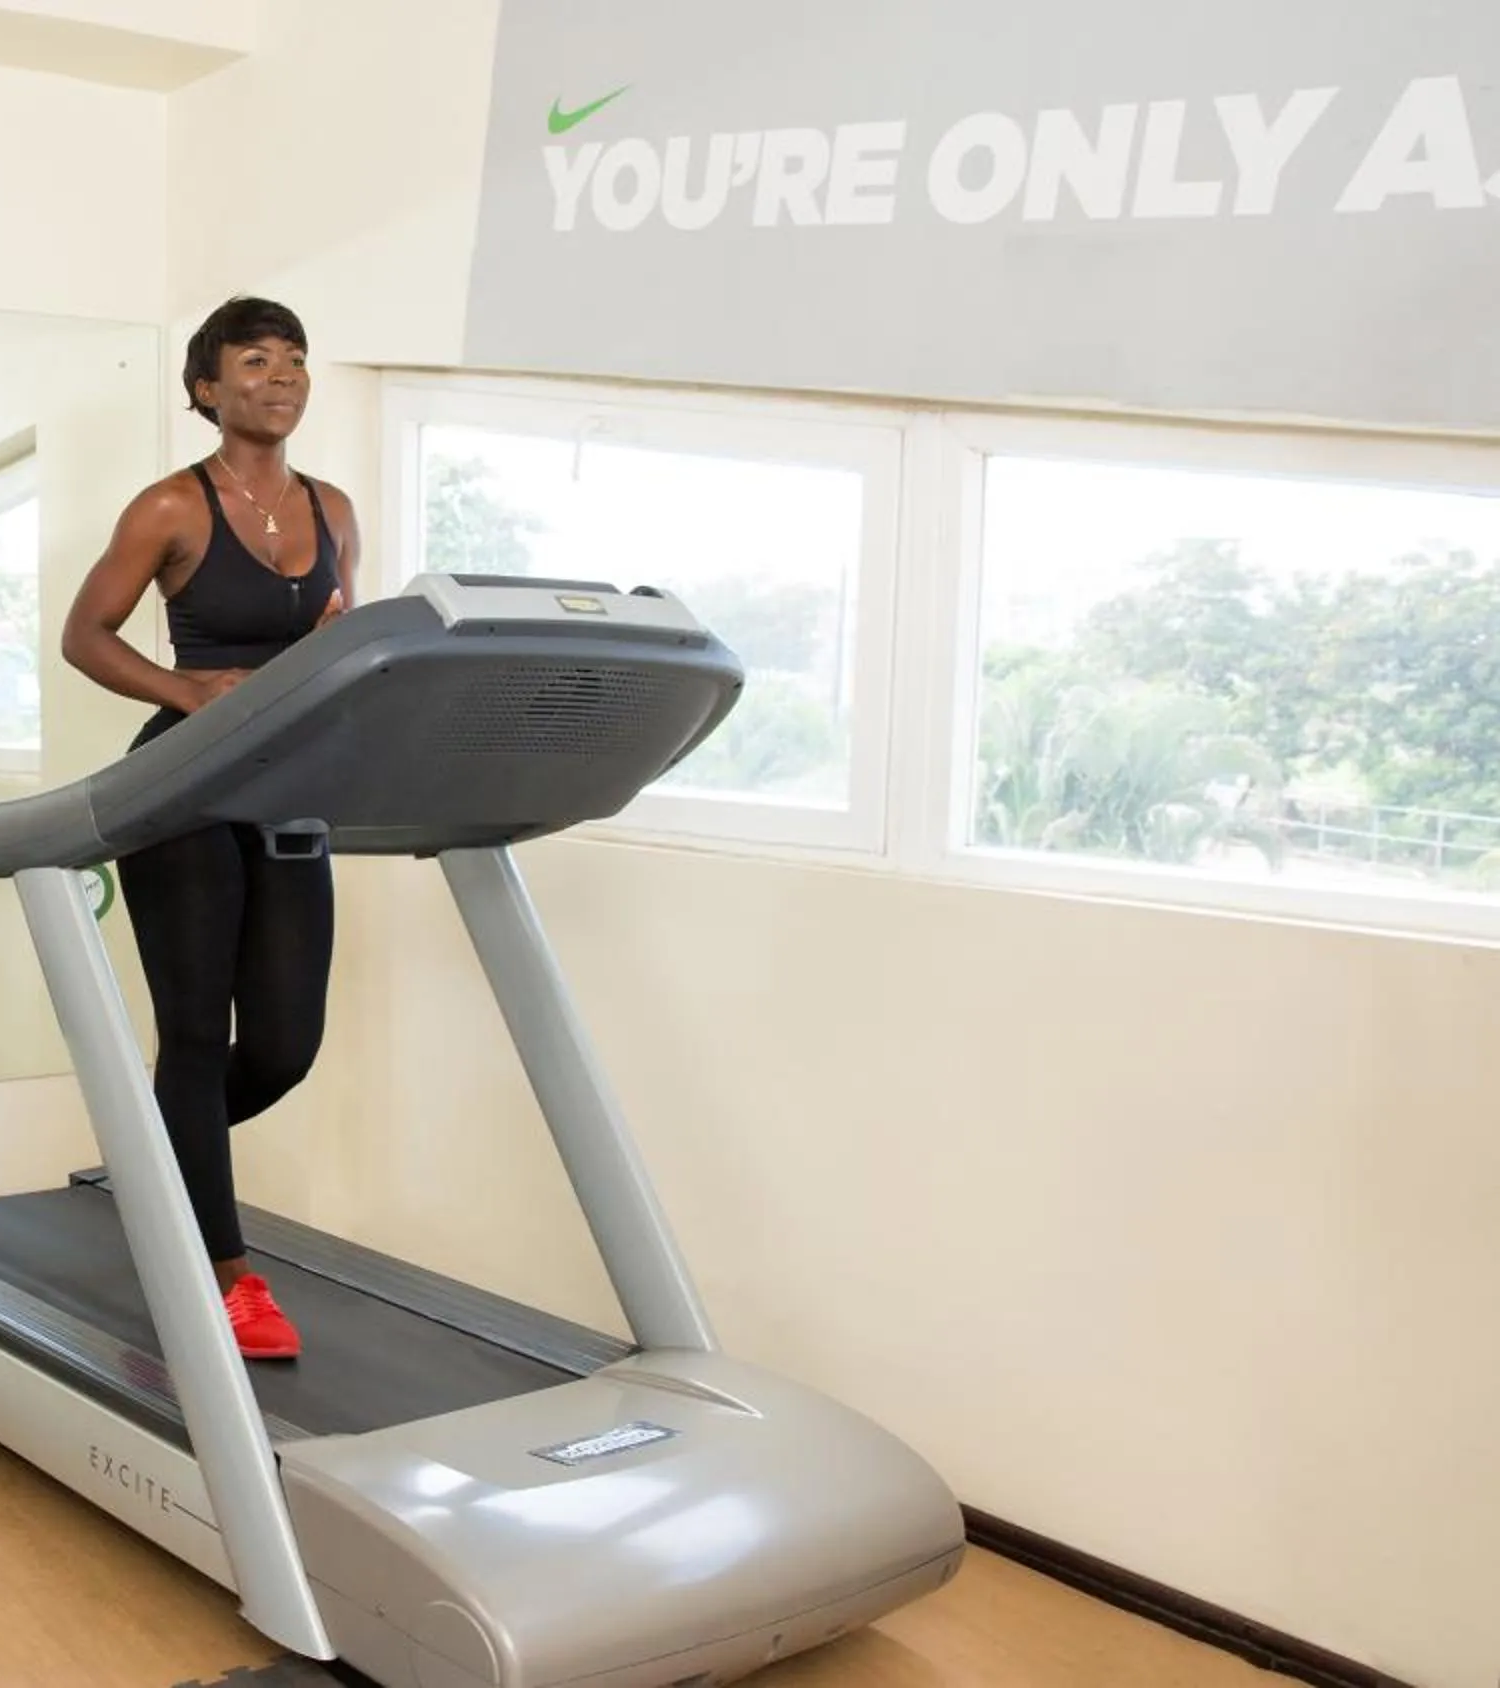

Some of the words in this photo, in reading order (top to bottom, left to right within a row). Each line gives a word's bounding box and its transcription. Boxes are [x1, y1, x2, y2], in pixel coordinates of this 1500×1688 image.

[543, 120, 906, 231] YOU'RE
[929, 86, 1340, 224] ONLY
[1333, 74, 1500, 211] A
[89, 1445, 171, 1513] EXCITE
